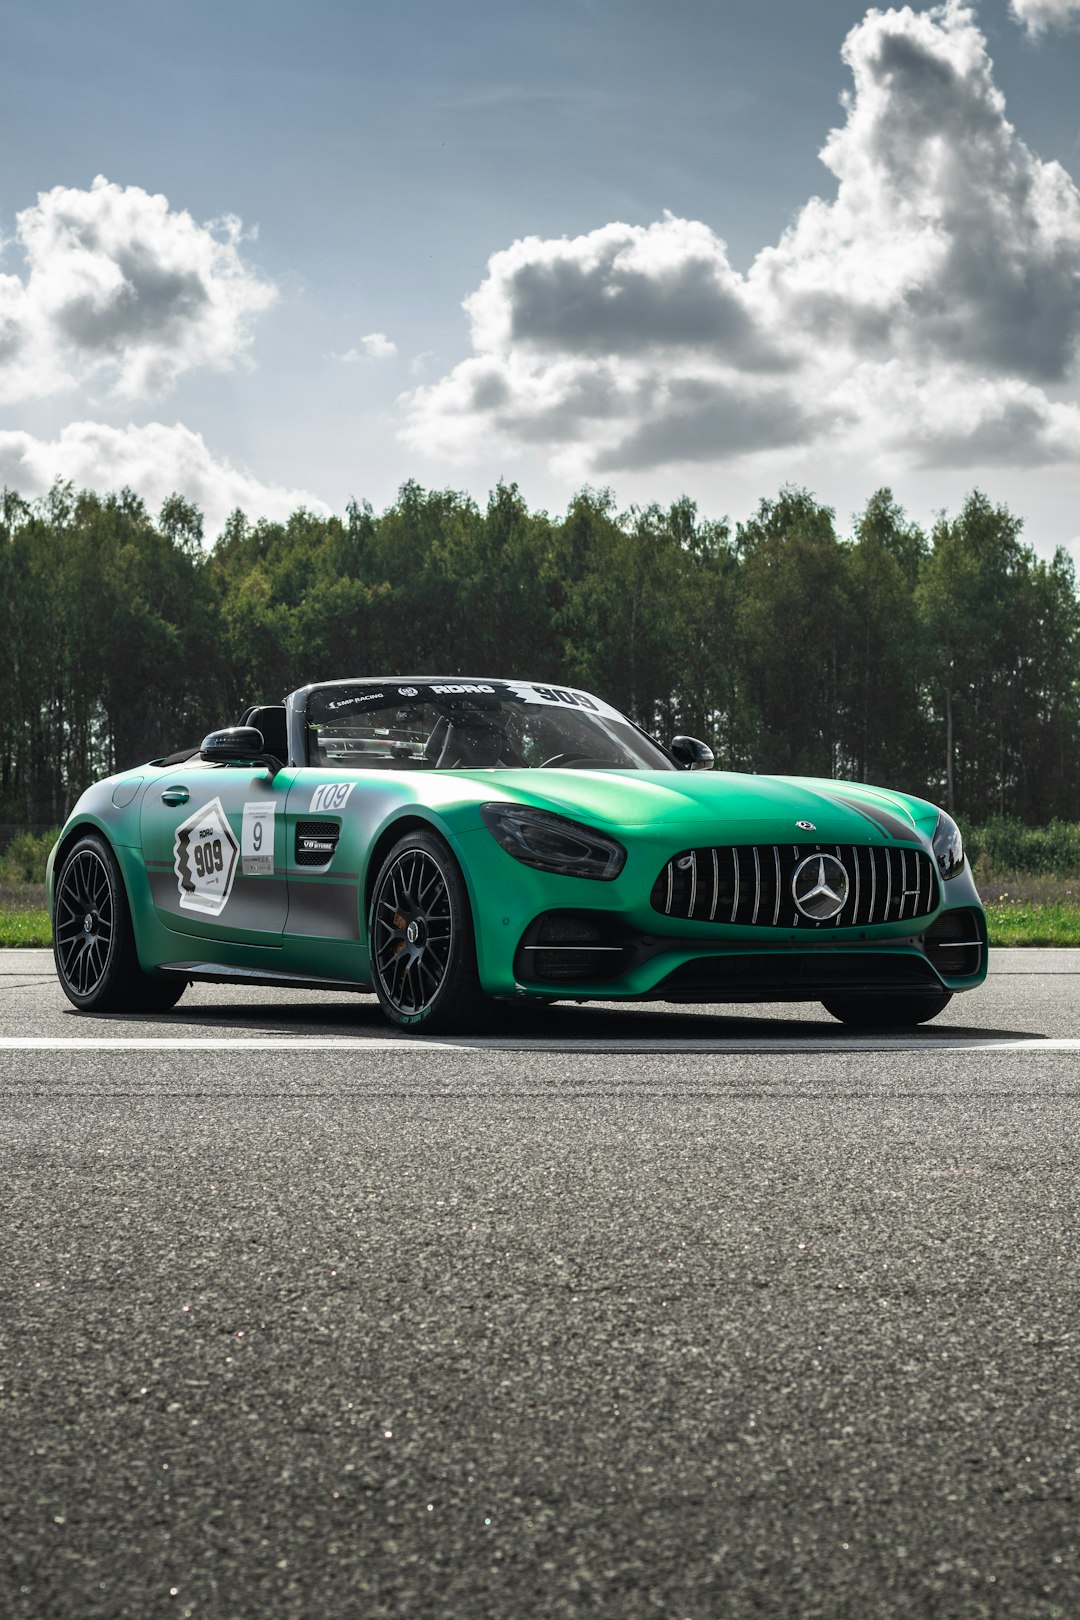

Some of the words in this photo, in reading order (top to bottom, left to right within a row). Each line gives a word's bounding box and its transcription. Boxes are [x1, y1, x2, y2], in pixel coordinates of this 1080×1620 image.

[336, 698, 354, 707] SMP
[354, 693, 384, 703] RACING
[531, 685, 599, 712] 909
[315, 783, 351, 811] 109
[253, 821, 263, 852] 9
[303, 840, 314, 849] V8
[194, 838, 224, 878] 909
